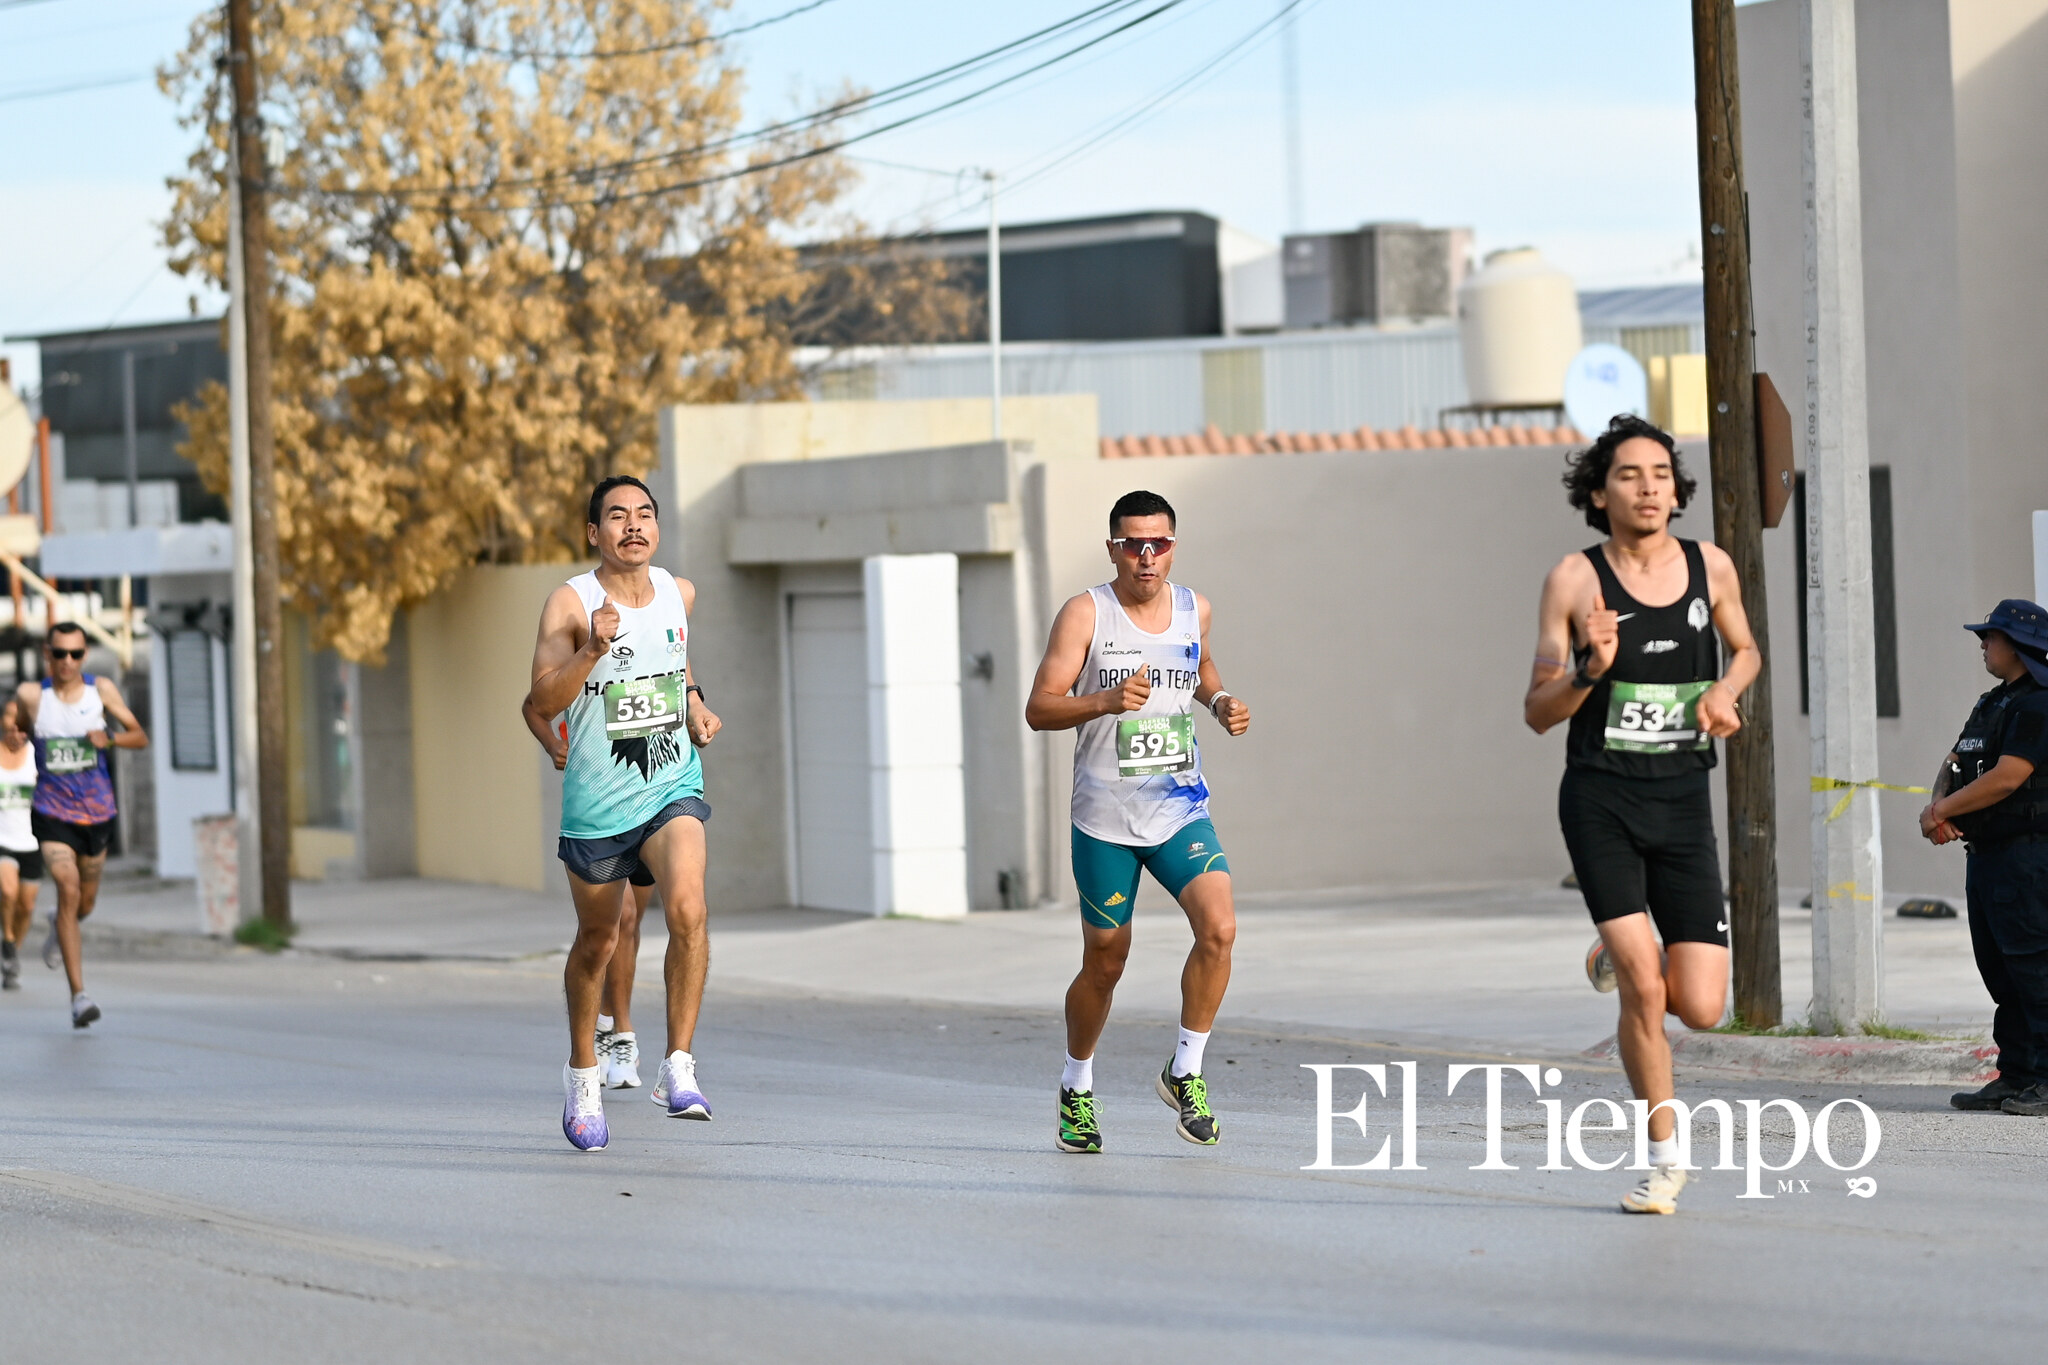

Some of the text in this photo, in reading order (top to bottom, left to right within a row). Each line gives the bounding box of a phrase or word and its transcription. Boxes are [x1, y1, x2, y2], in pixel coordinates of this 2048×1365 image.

[1099, 664, 1161, 688] ORDA
[617, 692, 668, 722] 535
[1620, 701, 1686, 732] 534
[1130, 731, 1180, 758] 595
